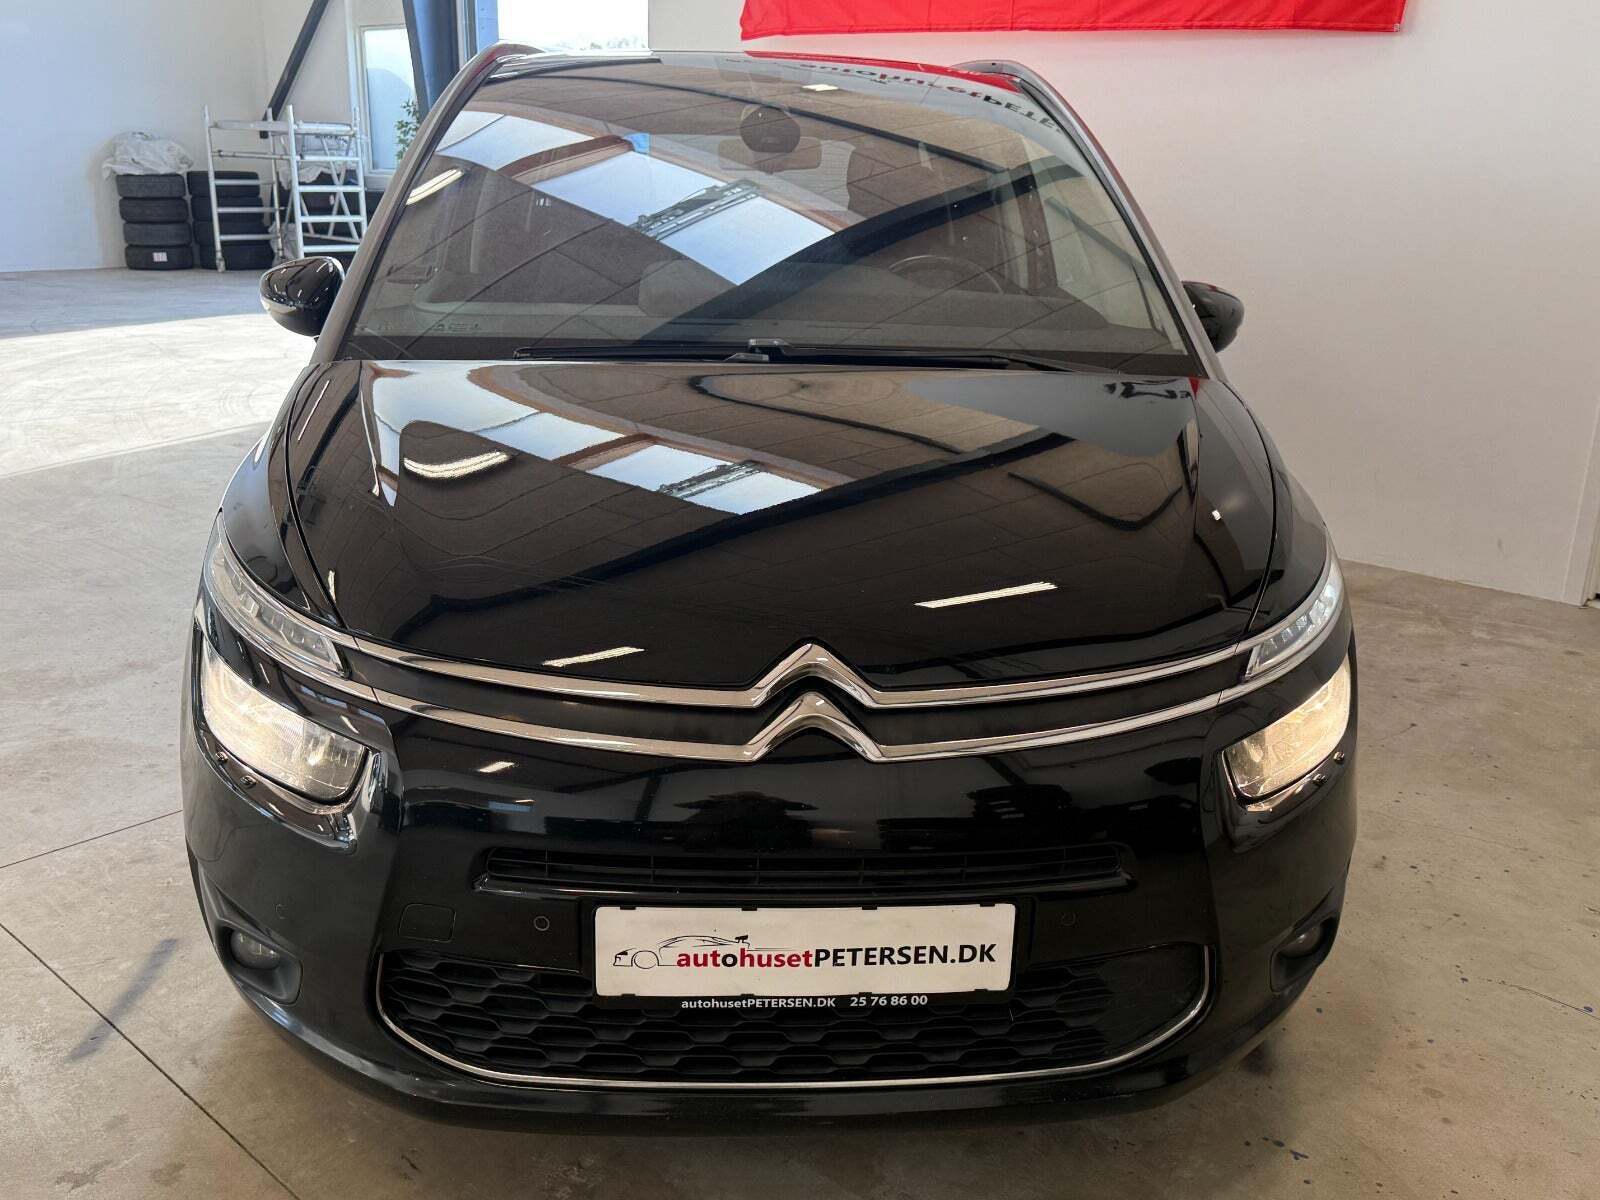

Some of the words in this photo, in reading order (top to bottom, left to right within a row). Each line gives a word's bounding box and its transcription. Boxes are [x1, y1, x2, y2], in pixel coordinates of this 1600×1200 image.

[676, 943, 997, 968] autohusetPETERSEN.DK
[681, 997, 836, 1009] autohusetPETERSEN.DK
[850, 996, 867, 1007] 25
[870, 996, 887, 1007] 76
[890, 995, 908, 1007] 86
[910, 995, 928, 1006] 00
